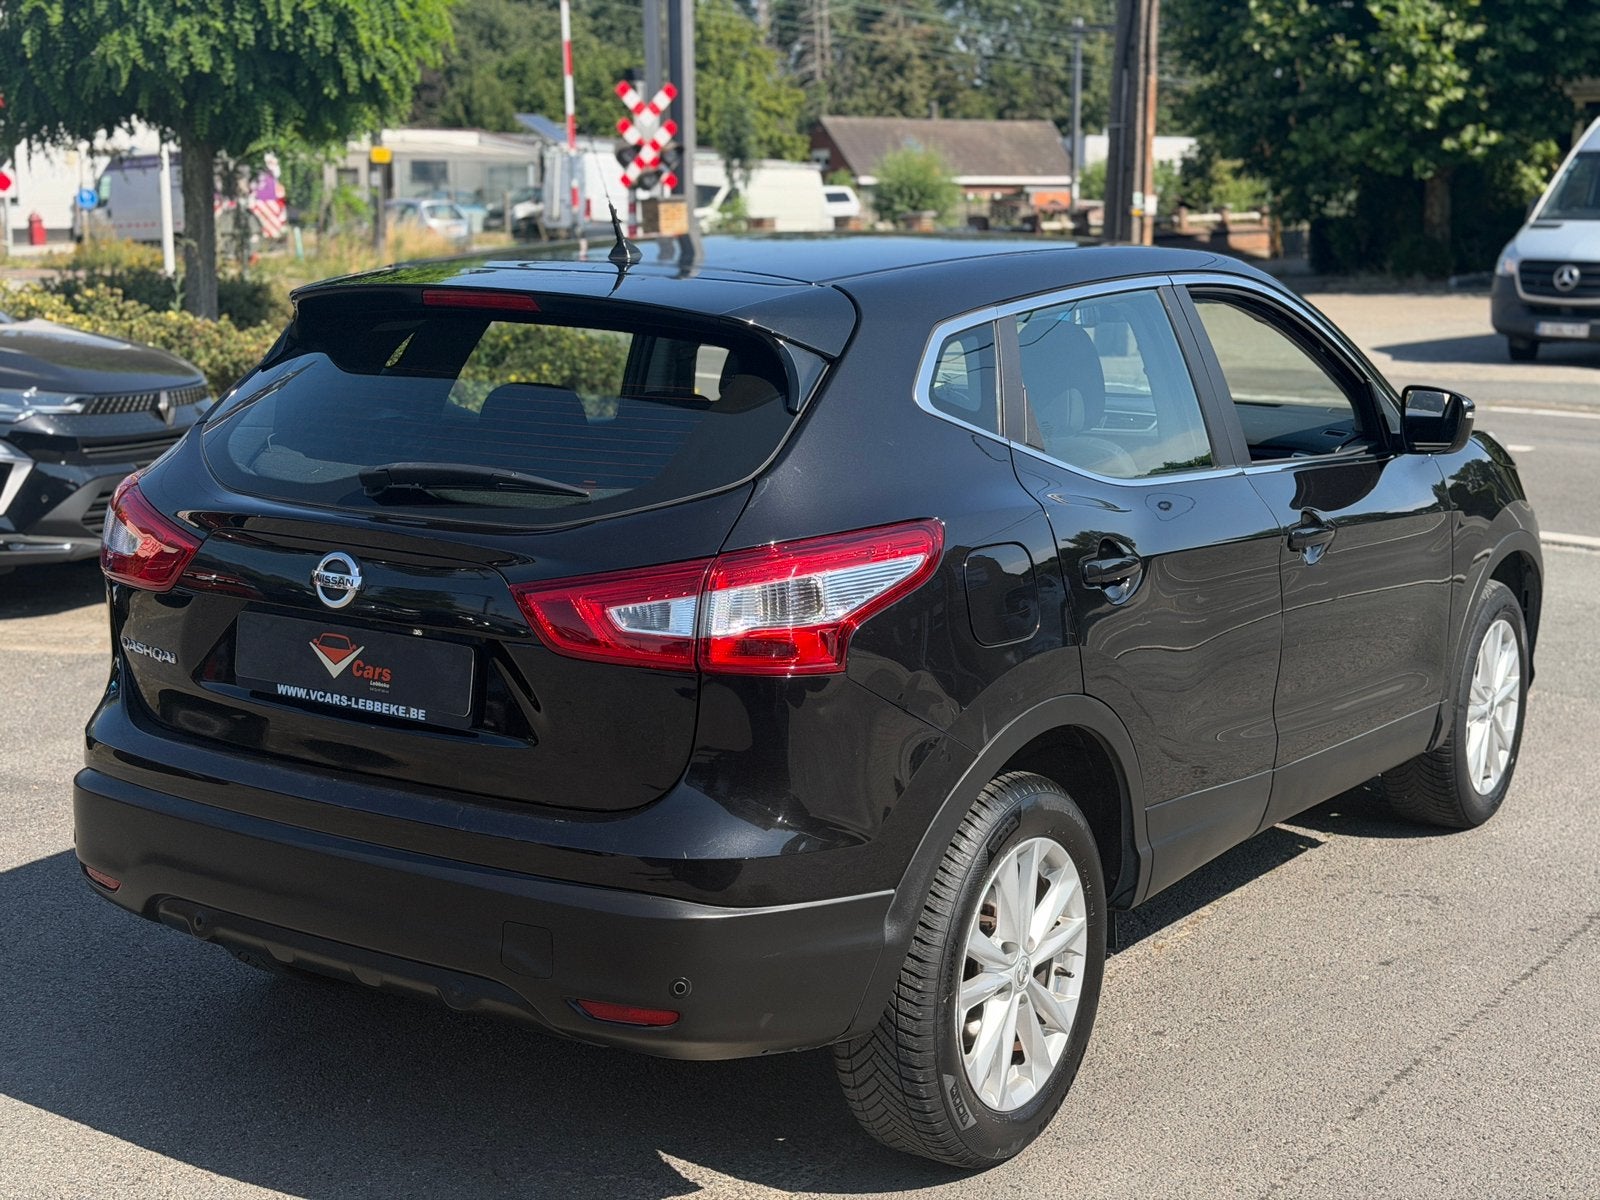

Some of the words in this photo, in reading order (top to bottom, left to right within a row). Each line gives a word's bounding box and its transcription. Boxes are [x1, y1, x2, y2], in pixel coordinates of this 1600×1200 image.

[315, 573, 354, 586] NISSAN
[121, 636, 176, 664] QASHQAI
[277, 683, 426, 721] WWW.VCARS-LEBBEKE.BE
